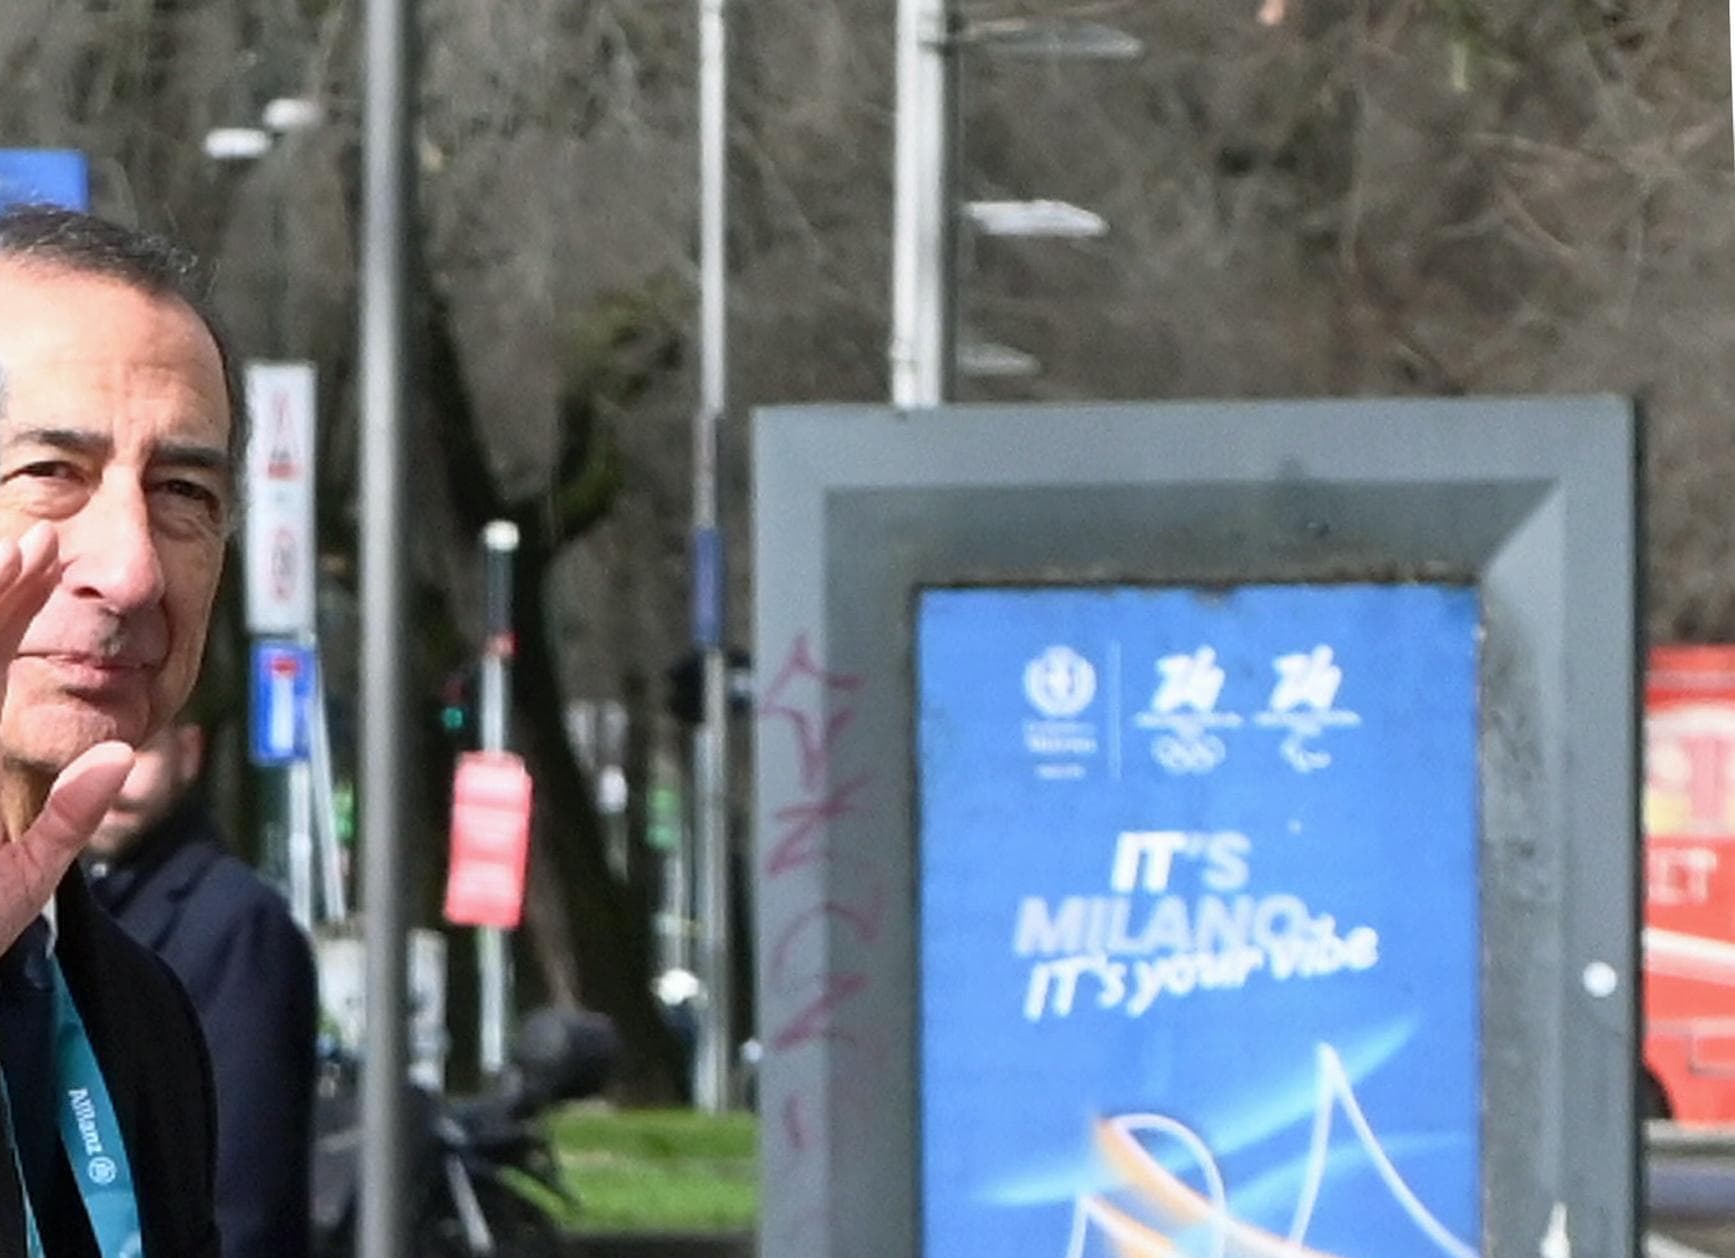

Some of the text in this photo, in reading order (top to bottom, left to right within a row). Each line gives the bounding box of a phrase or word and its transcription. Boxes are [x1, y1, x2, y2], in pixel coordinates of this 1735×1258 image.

[1111, 832, 1252, 893] IT'S
[1014, 895, 1312, 957] MILANO
[68, 1087, 102, 1156] Allianz
